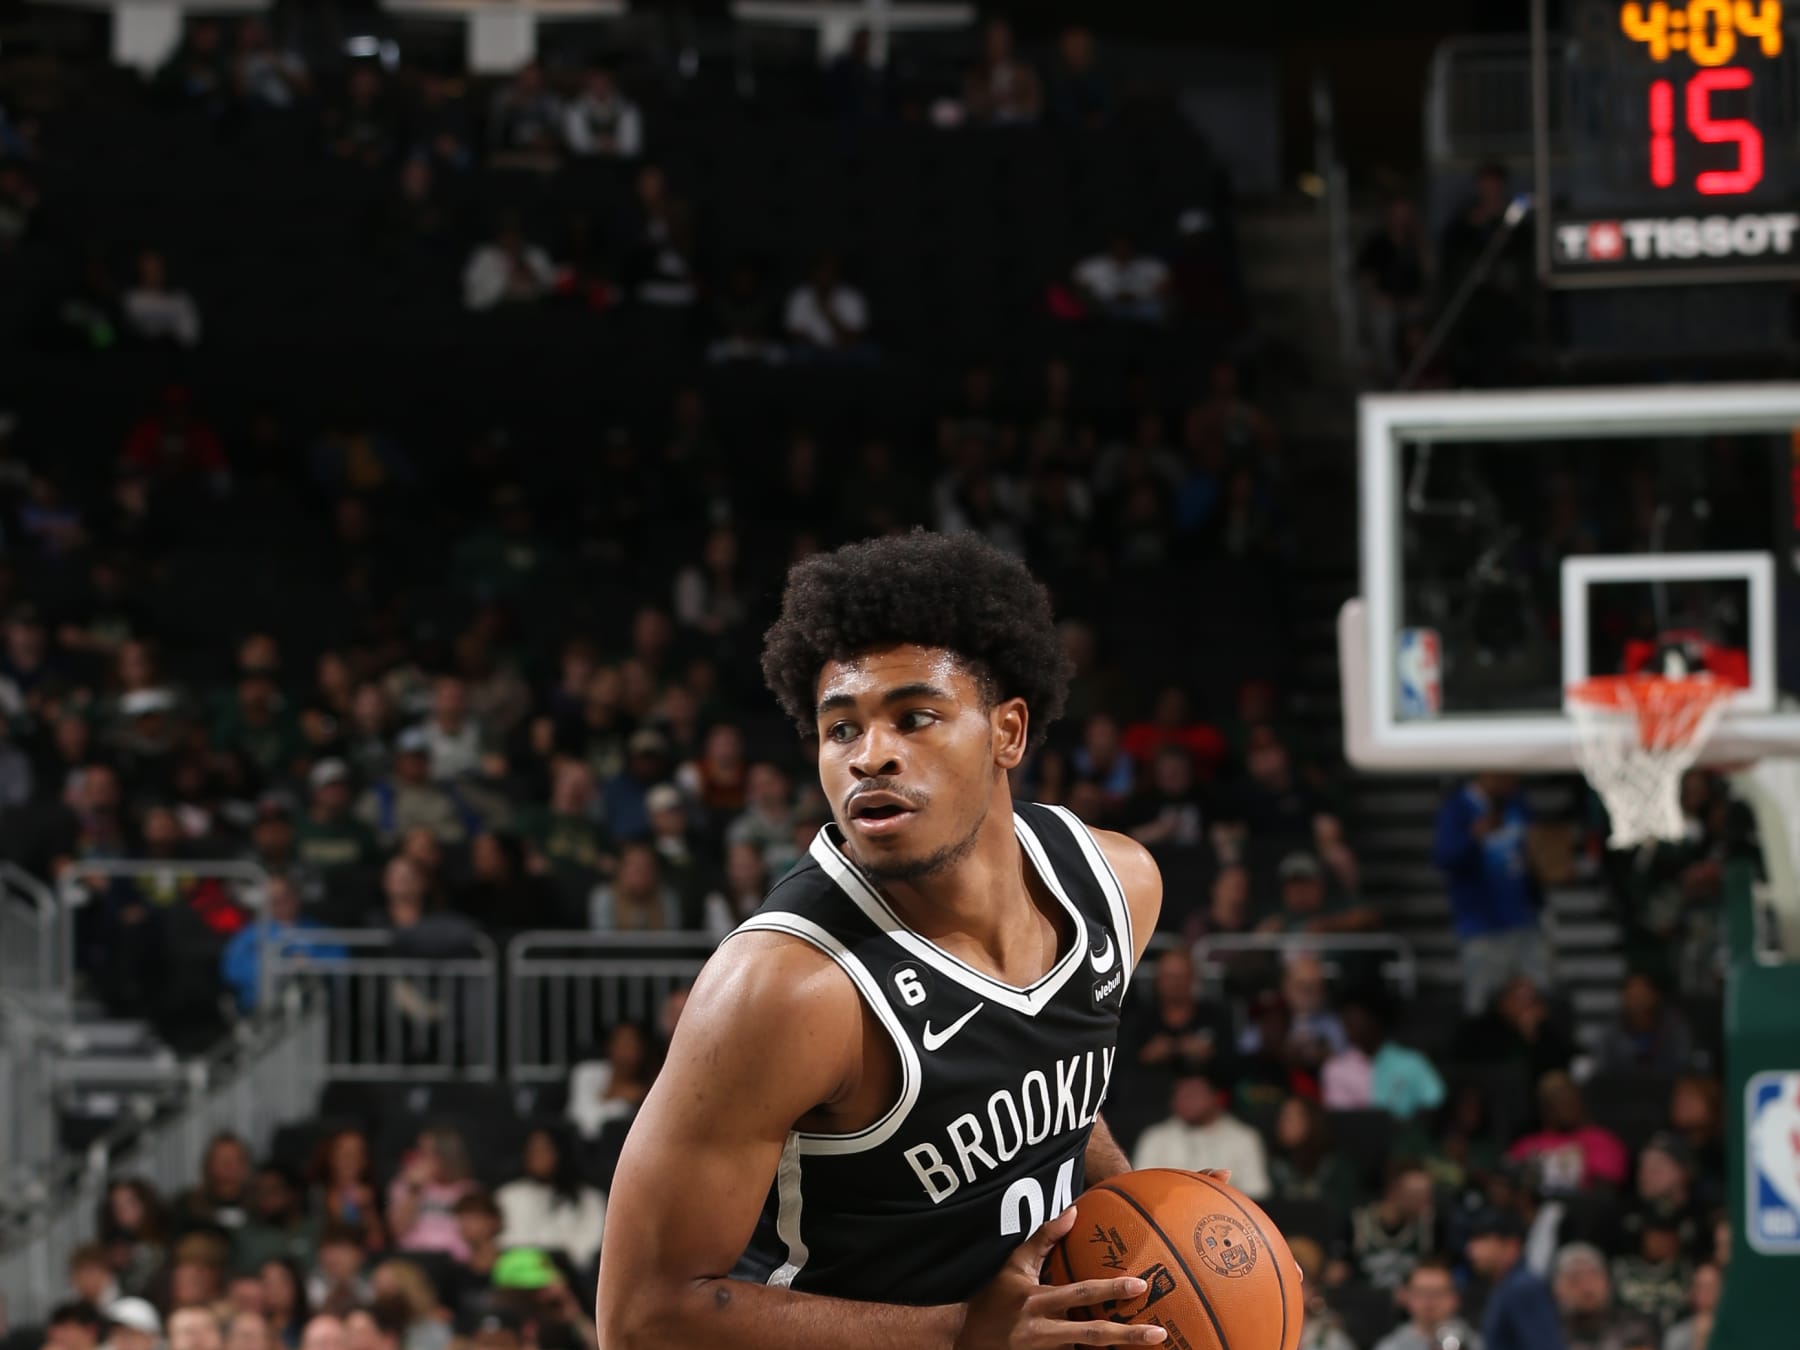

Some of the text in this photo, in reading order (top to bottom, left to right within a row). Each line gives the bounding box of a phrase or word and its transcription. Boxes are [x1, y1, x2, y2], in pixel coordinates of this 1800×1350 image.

[1620, 0, 1783, 67] 4:04
[1649, 66, 1764, 195] 15
[1623, 212, 1799, 260] TISSOT
[894, 968, 927, 1007] 6
[1095, 970, 1121, 1003] Webull
[904, 1046, 1116, 1205] BROOKLY
